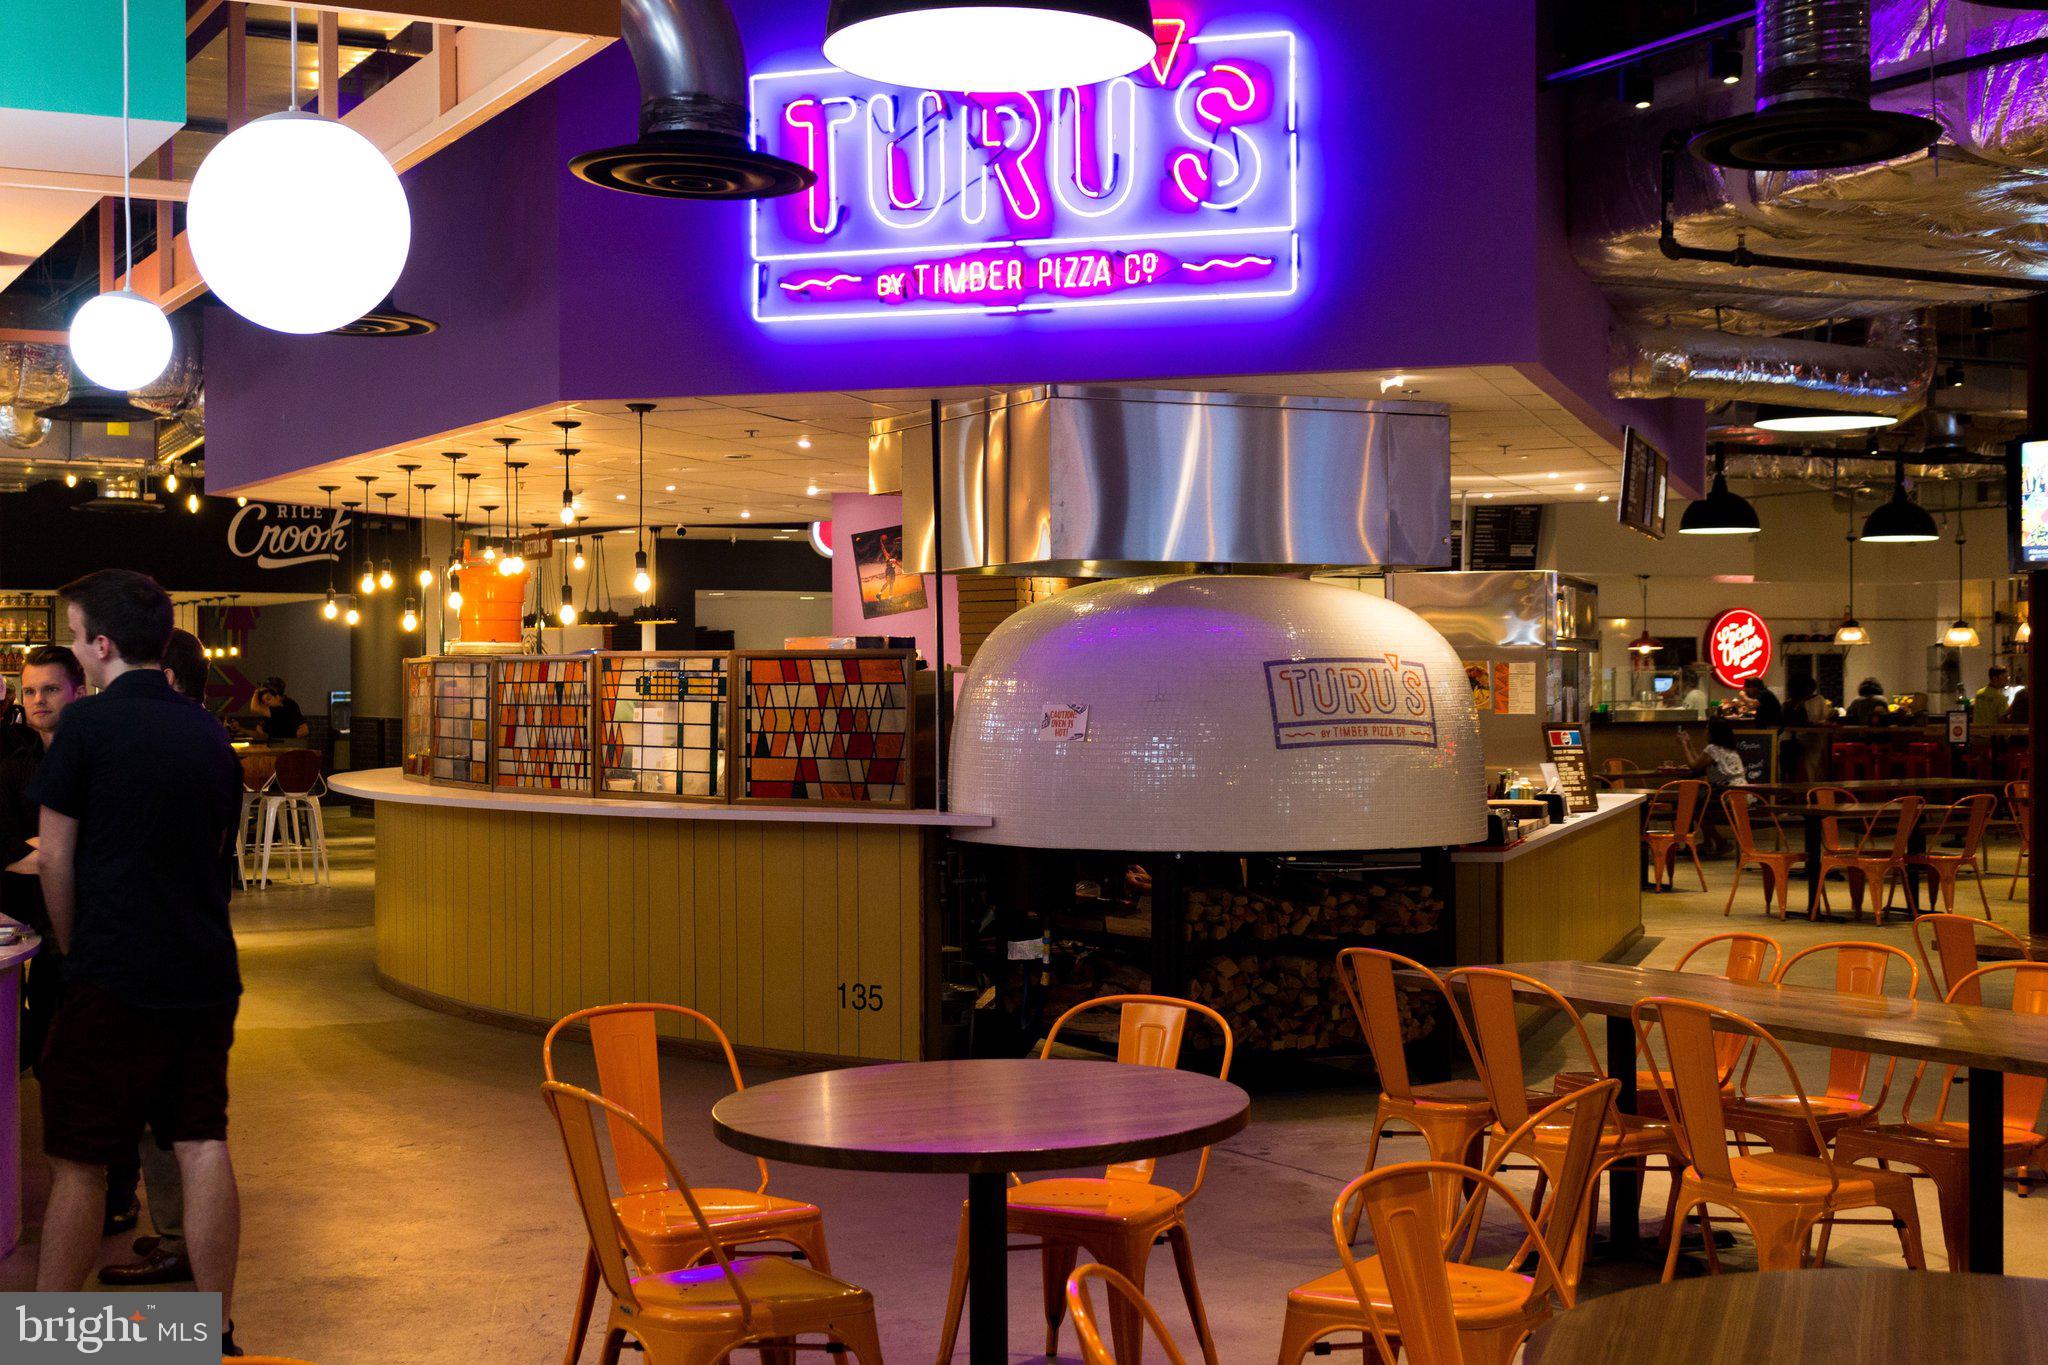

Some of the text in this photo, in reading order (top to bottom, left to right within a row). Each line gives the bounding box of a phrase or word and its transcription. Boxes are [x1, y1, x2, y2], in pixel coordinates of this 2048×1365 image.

[877, 273, 906, 296] BY
[913, 259, 1023, 296] TIMBER
[1037, 256, 1112, 290] PIZZA
[277, 504, 323, 519] RICE
[228, 503, 351, 557] Crook
[1279, 653, 1426, 717] TURU'S
[1332, 726, 1369, 738] TIMBER
[1371, 725, 1394, 737] PIZZA
[837, 982, 884, 1012] 135
